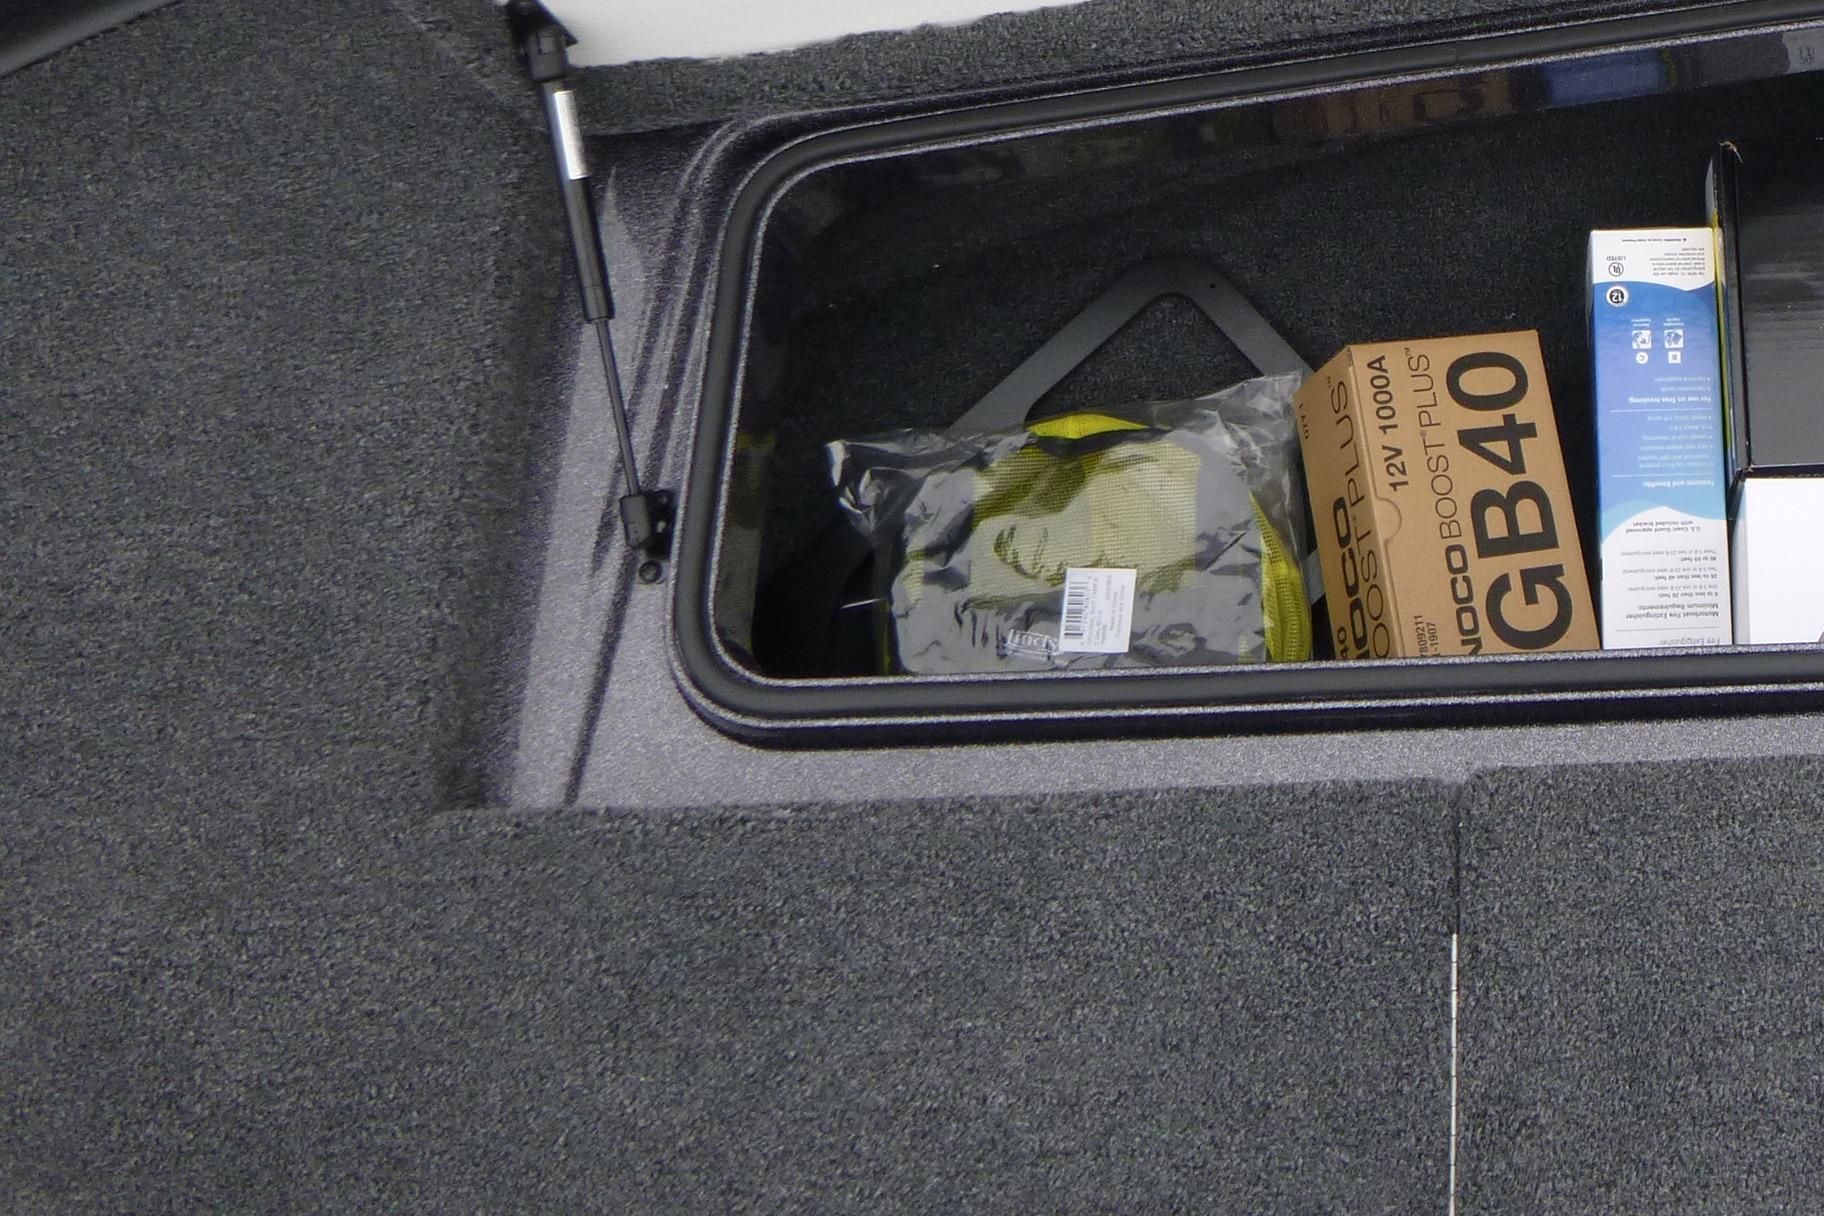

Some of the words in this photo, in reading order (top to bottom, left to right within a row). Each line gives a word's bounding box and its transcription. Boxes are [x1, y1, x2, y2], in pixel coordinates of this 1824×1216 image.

[1612, 292, 1623, 301] 12
[1300, 410, 1310, 439] QTY
[1366, 355, 1398, 435] 1000A
[1382, 445, 1409, 491] 12V
[1445, 352, 1573, 650] GB40
[1354, 525, 1390, 658] OOST
[1445, 544, 1482, 657] NOCO
